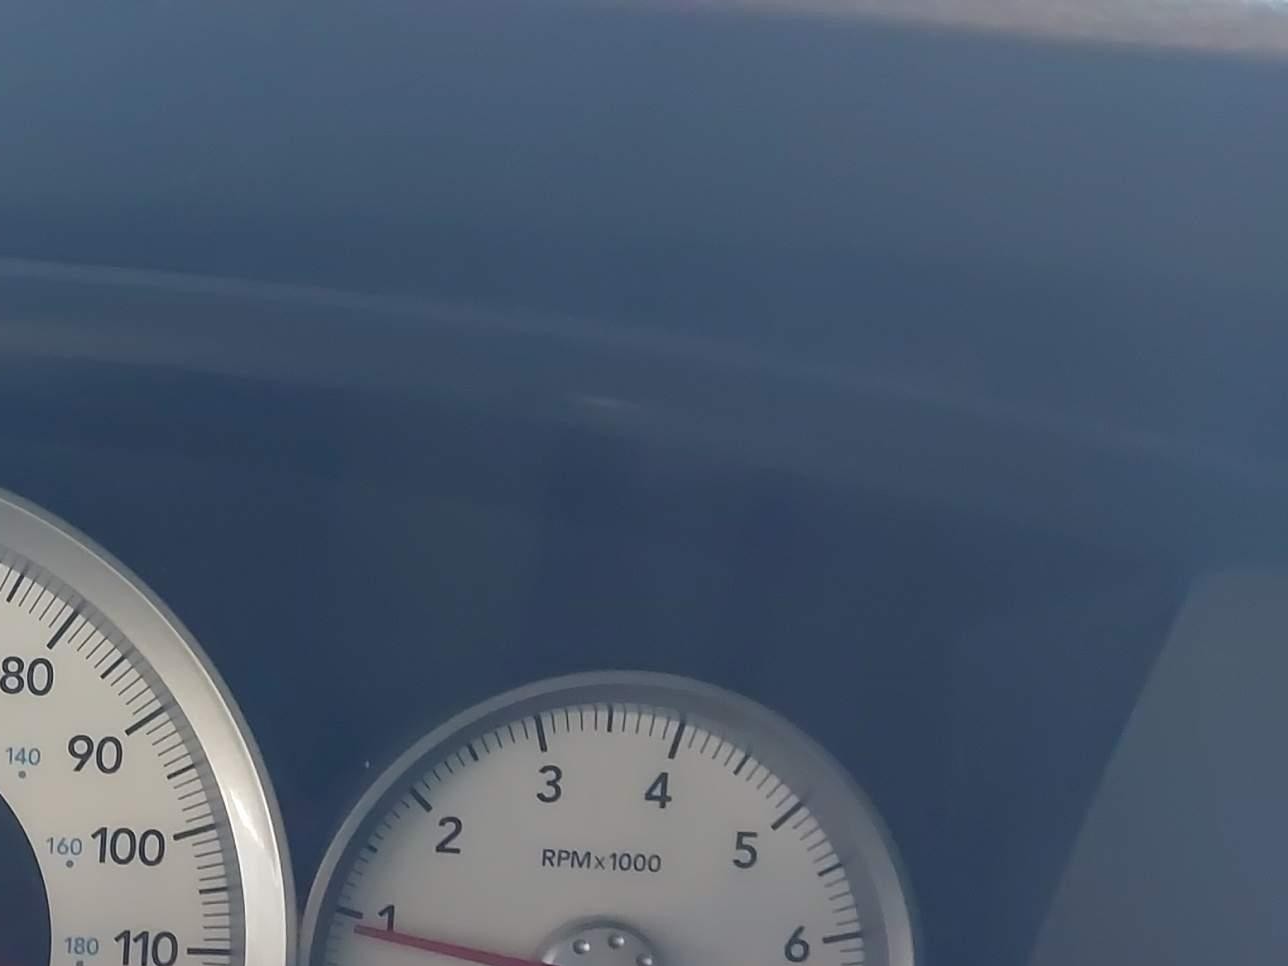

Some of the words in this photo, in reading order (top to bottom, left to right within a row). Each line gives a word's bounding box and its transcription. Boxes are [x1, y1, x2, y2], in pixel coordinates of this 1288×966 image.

[0, 656, 54, 696] 80
[6, 747, 41, 766] 140
[67, 735, 123, 774] 90
[536, 765, 563, 803] 3
[644, 772, 672, 809] 4
[46, 837, 83, 856] 160
[91, 827, 165, 866] 100
[435, 816, 463, 854] 2
[732, 831, 759, 868] 5
[378, 904, 398, 935] 1
[64, 937, 99, 956] 180
[783, 926, 811, 963] 6
